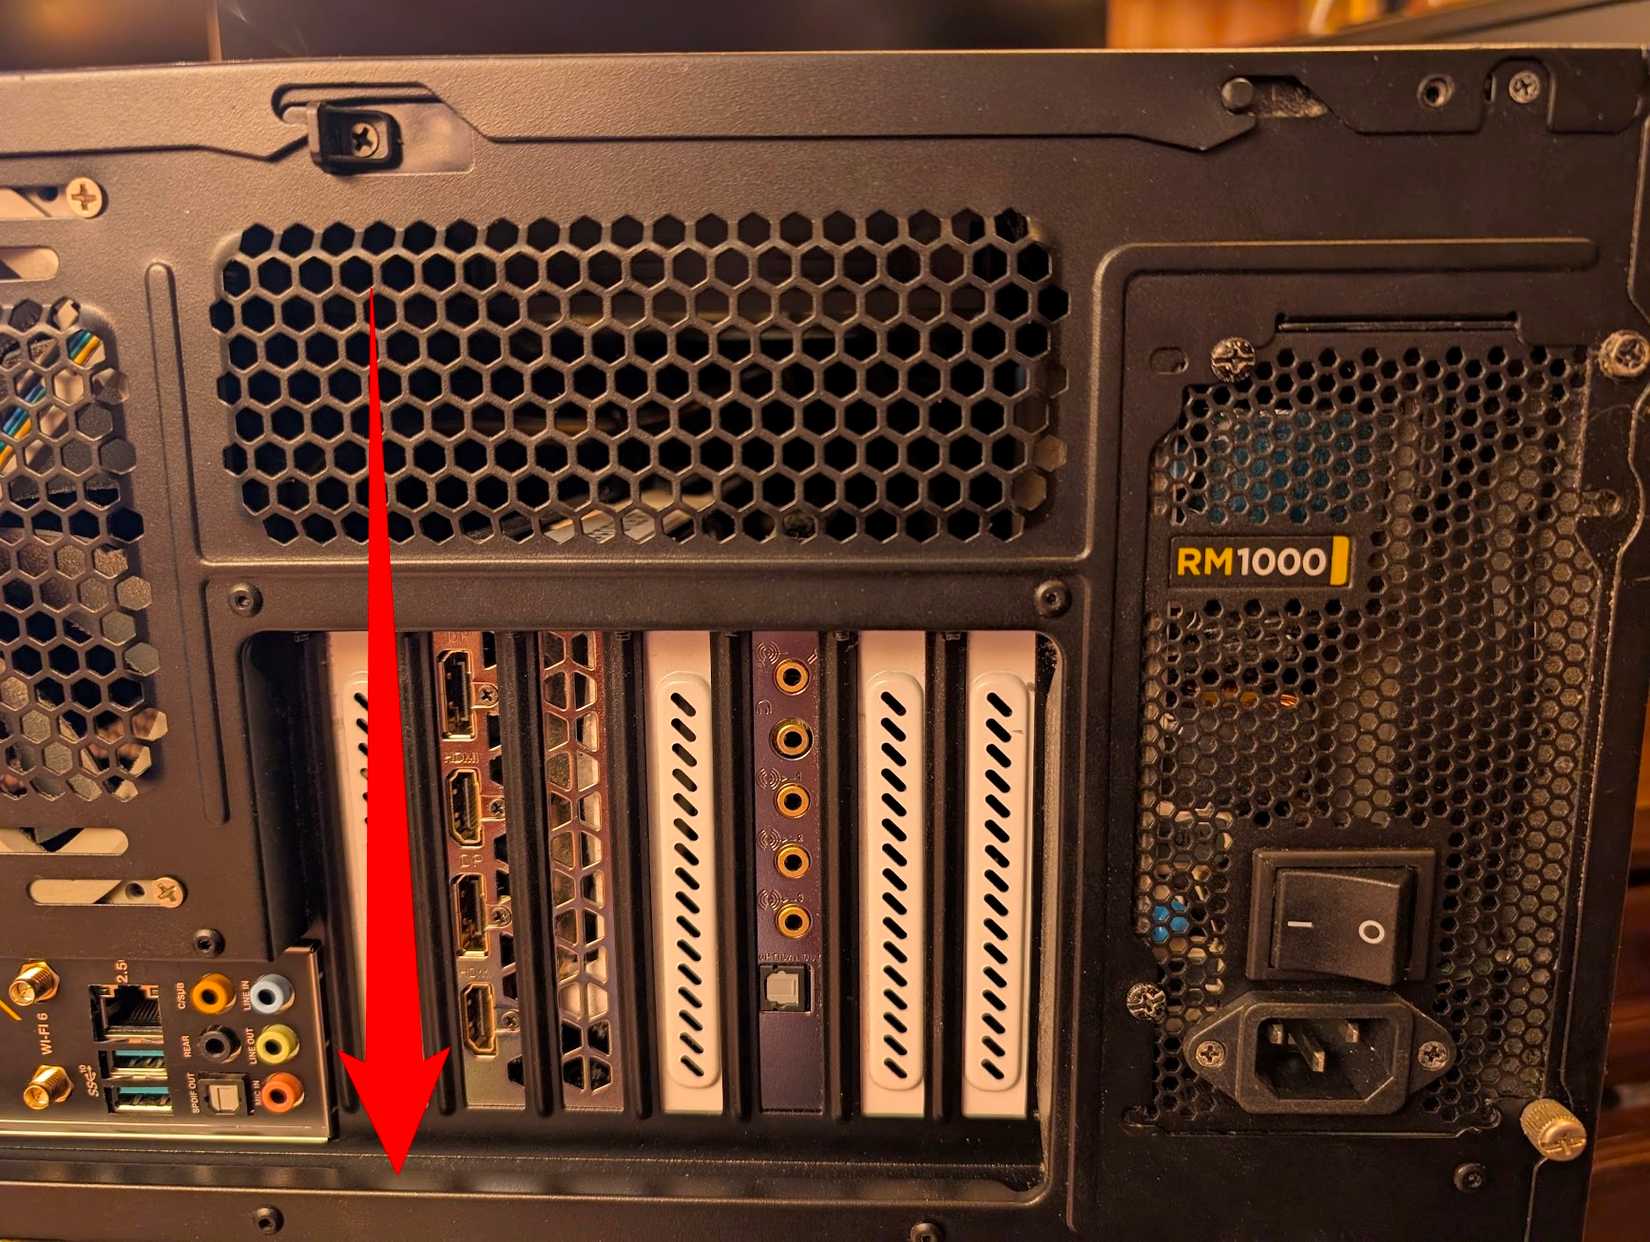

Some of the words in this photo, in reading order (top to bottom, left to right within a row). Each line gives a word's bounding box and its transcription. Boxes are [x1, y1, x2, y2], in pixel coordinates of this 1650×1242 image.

[1177, 547, 1327, 577] RM1000
[241, 980, 250, 990] IN
[176, 981, 187, 1010] C/SUB
[242, 991, 252, 1011] LINE
[36, 1012, 49, 1022] 6
[37, 1025, 54, 1056] WI-FI
[245, 1027, 255, 1045] OUT
[182, 1035, 192, 1058] REAR
[248, 1046, 258, 1065] LINE
[186, 1072, 197, 1089] OUT
[252, 1080, 261, 1089] IN
